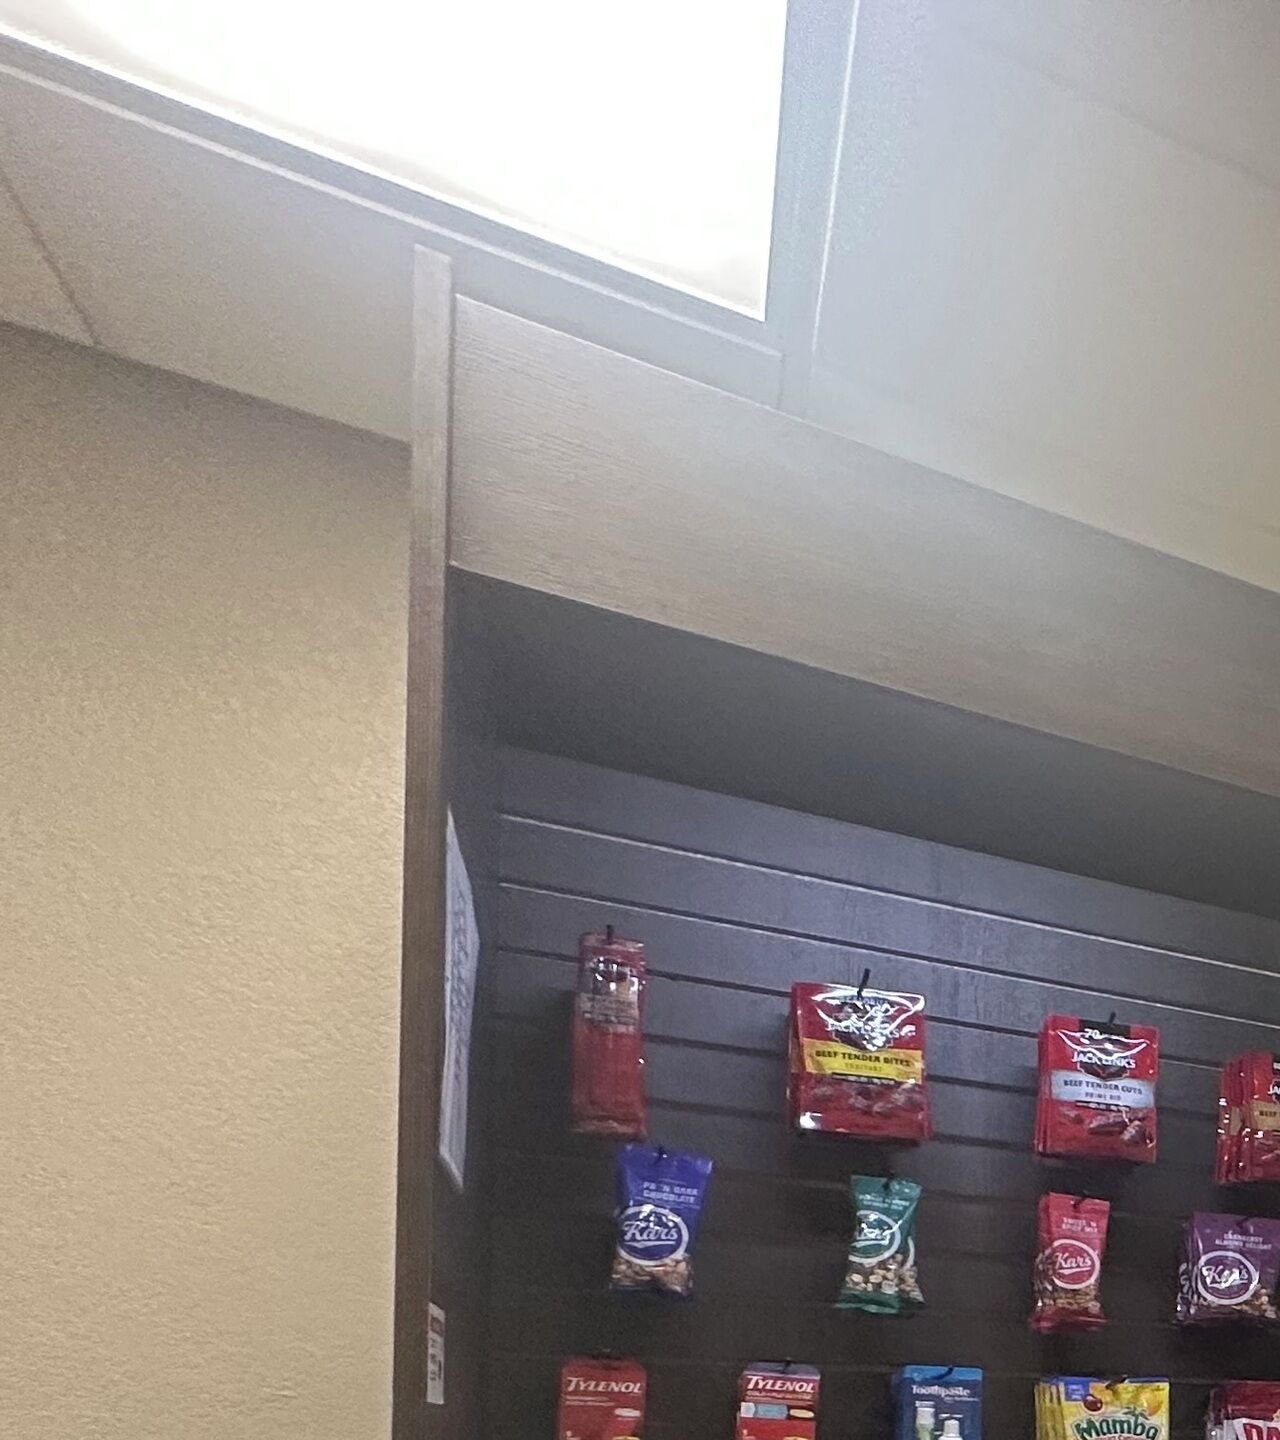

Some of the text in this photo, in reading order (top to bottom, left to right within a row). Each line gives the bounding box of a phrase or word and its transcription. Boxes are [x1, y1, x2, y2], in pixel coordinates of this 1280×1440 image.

[815, 1049, 911, 1067] BEEF TENDER BITES
[1072, 1051, 1102, 1065] JACK
[1063, 1079, 1143, 1095] BEEF TENDER CUTS
[566, 1377, 642, 1394] TYLENOL
[746, 1375, 815, 1394] TYLENOL
[911, 1383, 971, 1399] Toothpaste
